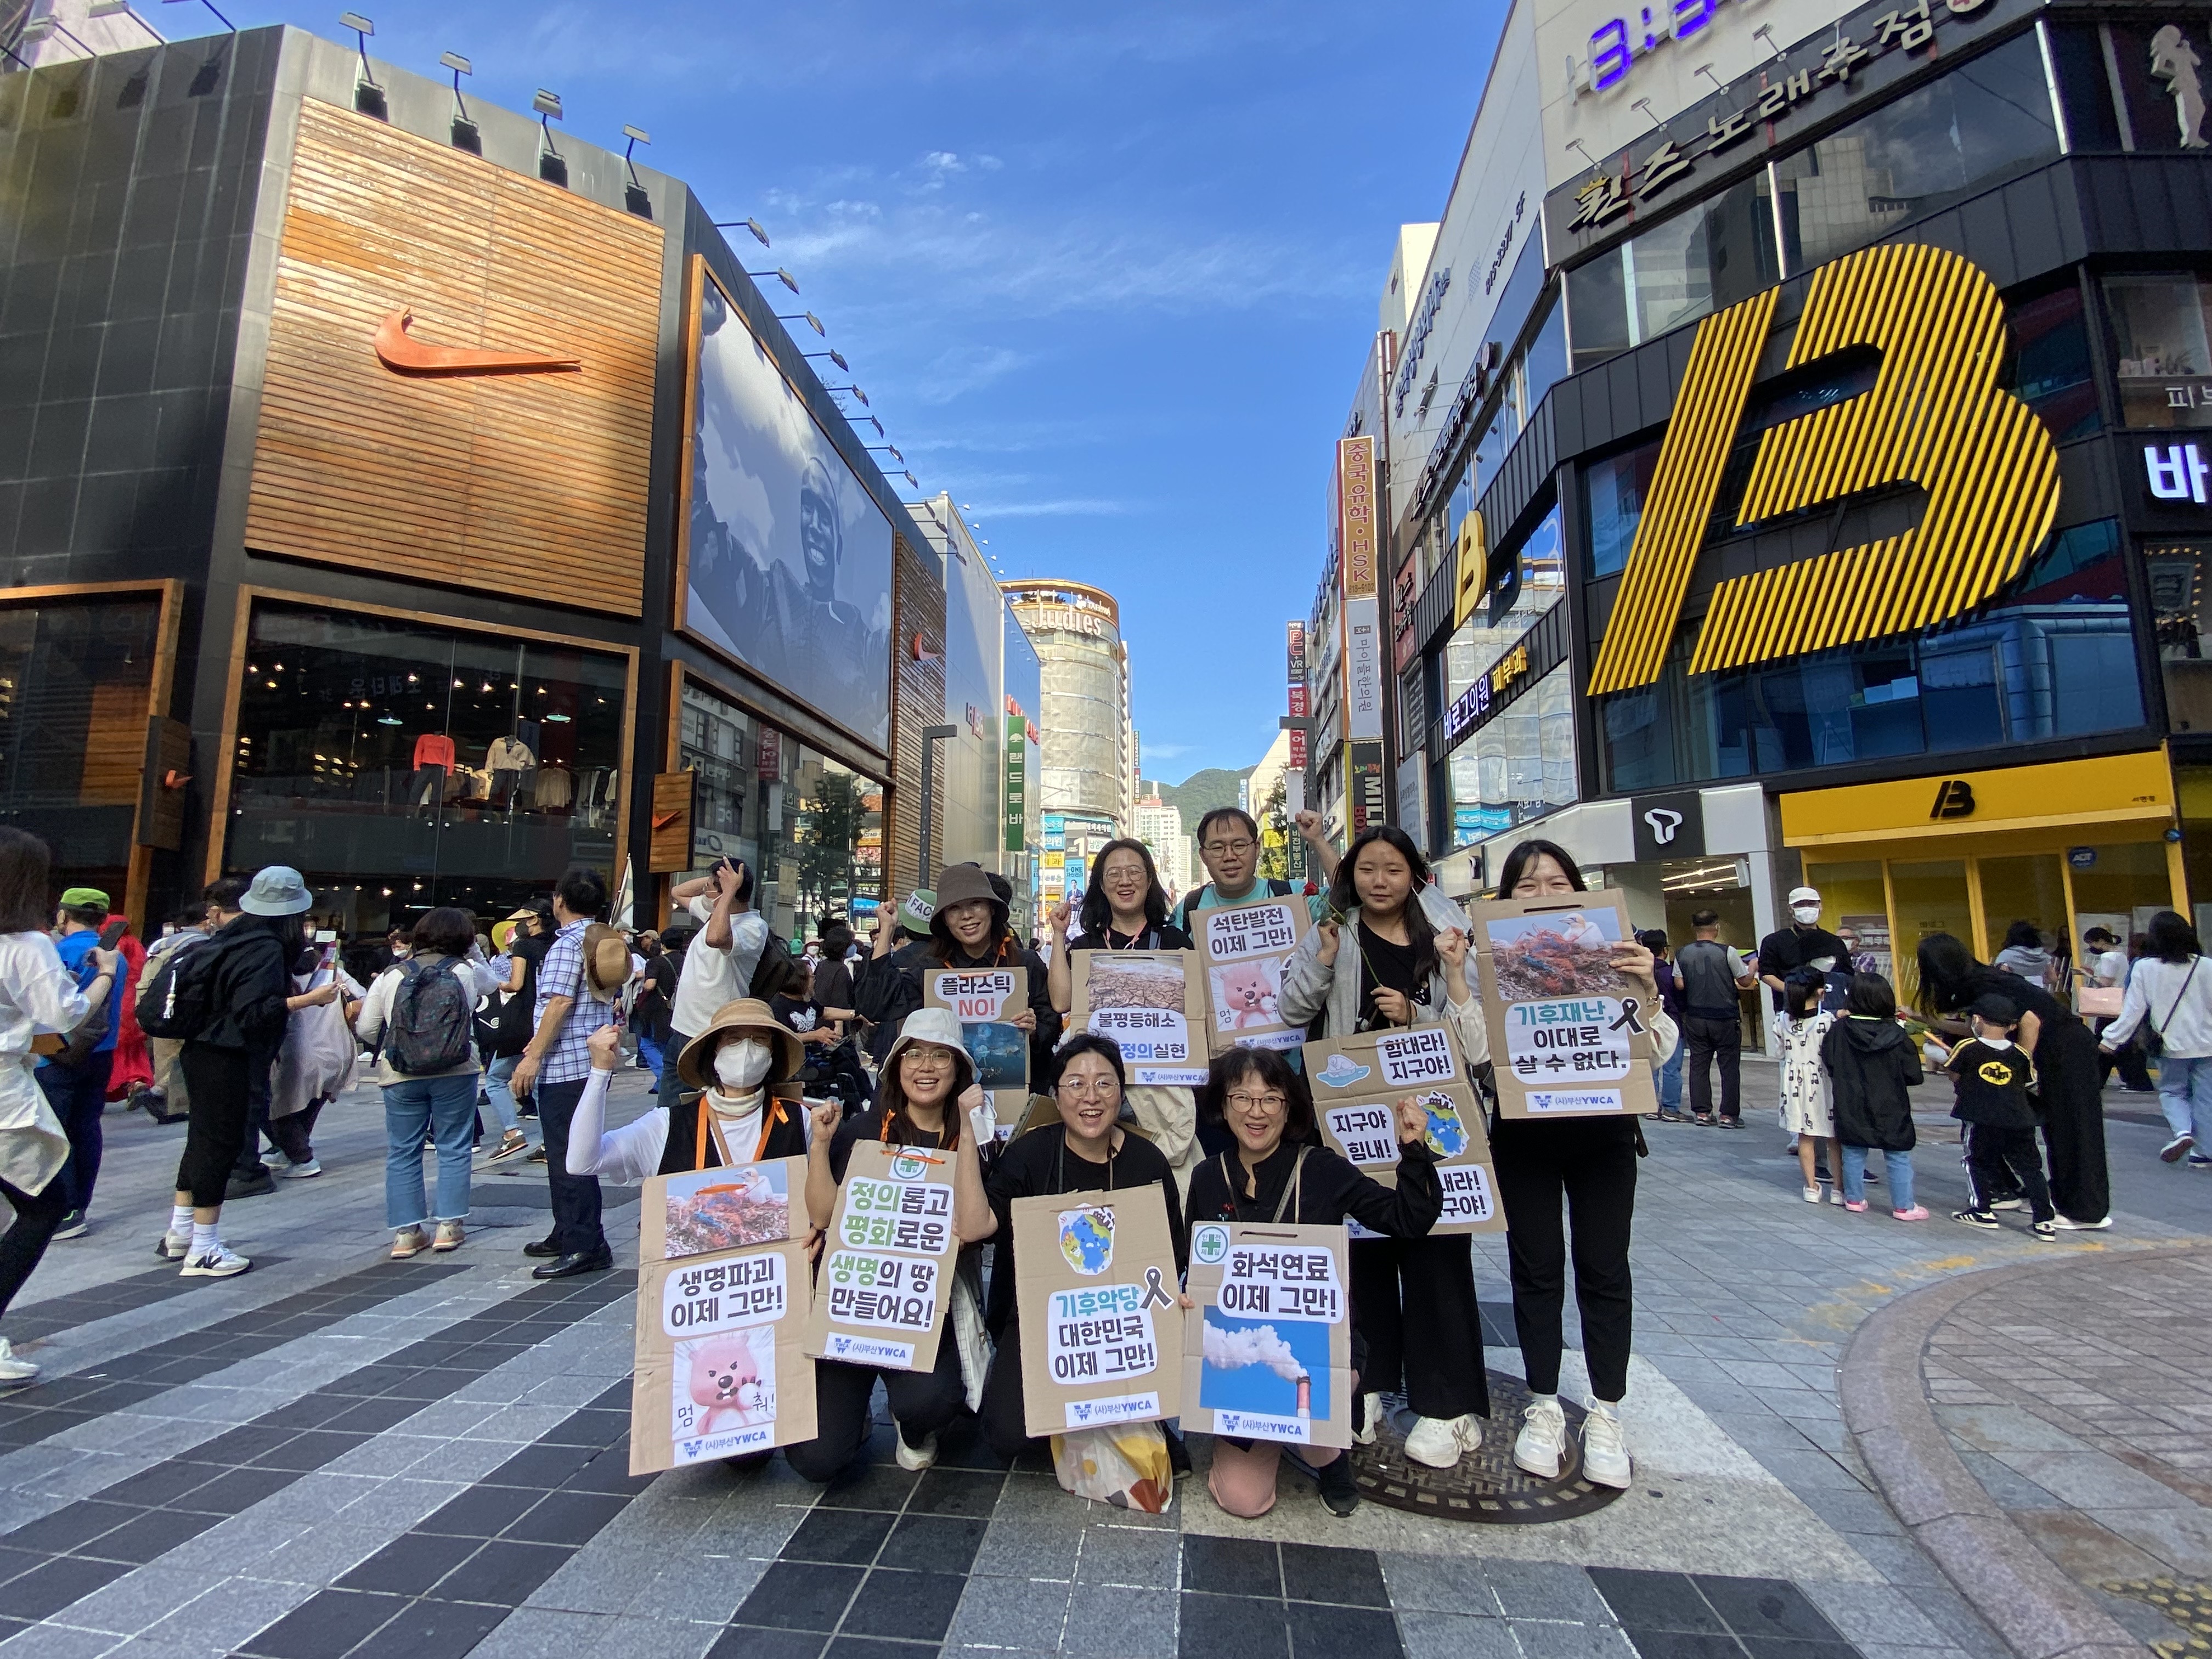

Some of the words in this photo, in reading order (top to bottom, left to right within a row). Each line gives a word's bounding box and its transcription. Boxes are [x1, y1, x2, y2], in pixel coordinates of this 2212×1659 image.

[1031, 602, 1102, 636] Judies
[1443, 674, 1489, 740] 바로그의원
[1492, 646, 1528, 693] 피부과
[1009, 752, 1023, 825] 랜드로바
[1213, 907, 1284, 933] 석탄발전
[1211, 935, 1247, 955] 이제
[1252, 927, 1294, 949] 그만!
[941, 975, 1011, 996] 플라스틱
[958, 997, 995, 1016] NO!
[1098, 1013, 1176, 1028] 불평등해소
[1514, 1001, 1614, 1026] 기후재난,
[1533, 1026, 1602, 1048] 이대로
[1389, 1055, 1451, 1080] 지구야!
[1515, 1056, 1537, 1075] 살
[1545, 1054, 1566, 1073] 수
[1572, 1050, 1627, 1071] 없다.
[1333, 1110, 1387, 1133] 지구야
[1347, 1138, 1391, 1160] 힘내!
[1442, 1171, 1481, 1192] 내라!
[851, 1181, 950, 1217] 정의롭고
[1438, 1195, 1487, 1217] 구야!
[844, 1214, 944, 1252] 평화로운
[678, 1257, 774, 1297] 생명파괴
[831, 1254, 903, 1289] 생명의
[910, 1263, 934, 1294] 땅
[1231, 1251, 1329, 1282] 화석연료
[671, 1299, 719, 1328] 이제
[726, 1285, 783, 1318] 그만!
[831, 1288, 934, 1328] 만들어요!
[1056, 1286, 1139, 1318] 기후악당
[1223, 1284, 1270, 1313] 이제
[1278, 1285, 1337, 1317] 그만!
[1058, 1315, 1144, 1348] 대한민국
[1054, 1351, 1098, 1378] 이제
[1105, 1342, 1155, 1374] 그만!
